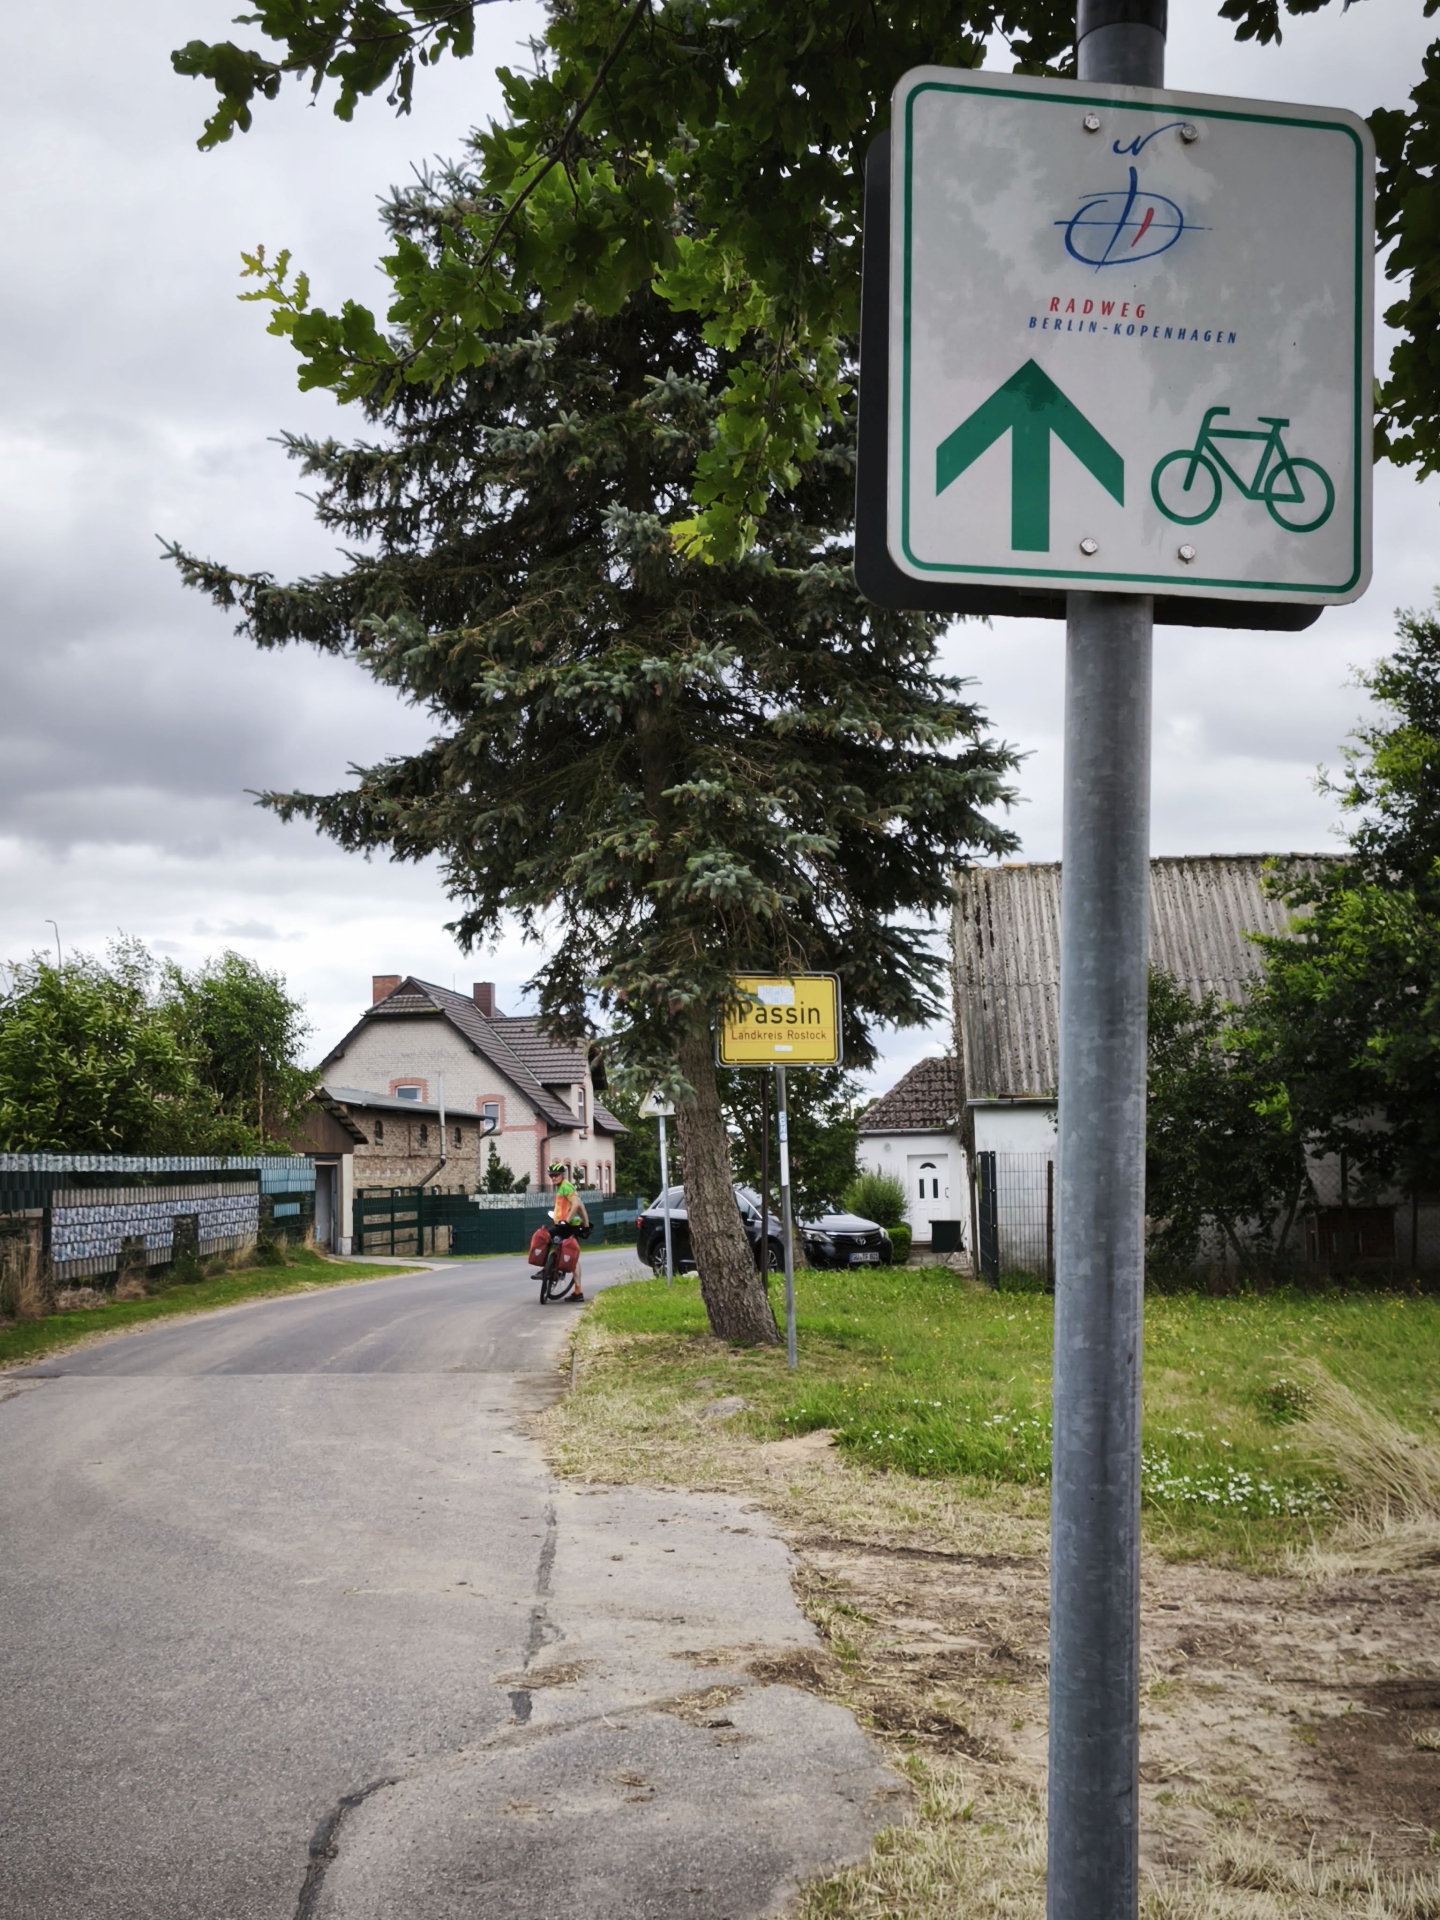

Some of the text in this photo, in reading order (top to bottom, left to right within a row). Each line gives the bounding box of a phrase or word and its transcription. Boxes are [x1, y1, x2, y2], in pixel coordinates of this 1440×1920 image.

[1049, 296, 1147, 319] RADWEG
[1028, 315, 1238, 344] BERLIN-KOPENHAGEN
[737, 1000, 821, 1025] Passin
[731, 1030, 827, 1041] Landkreis Rostock
